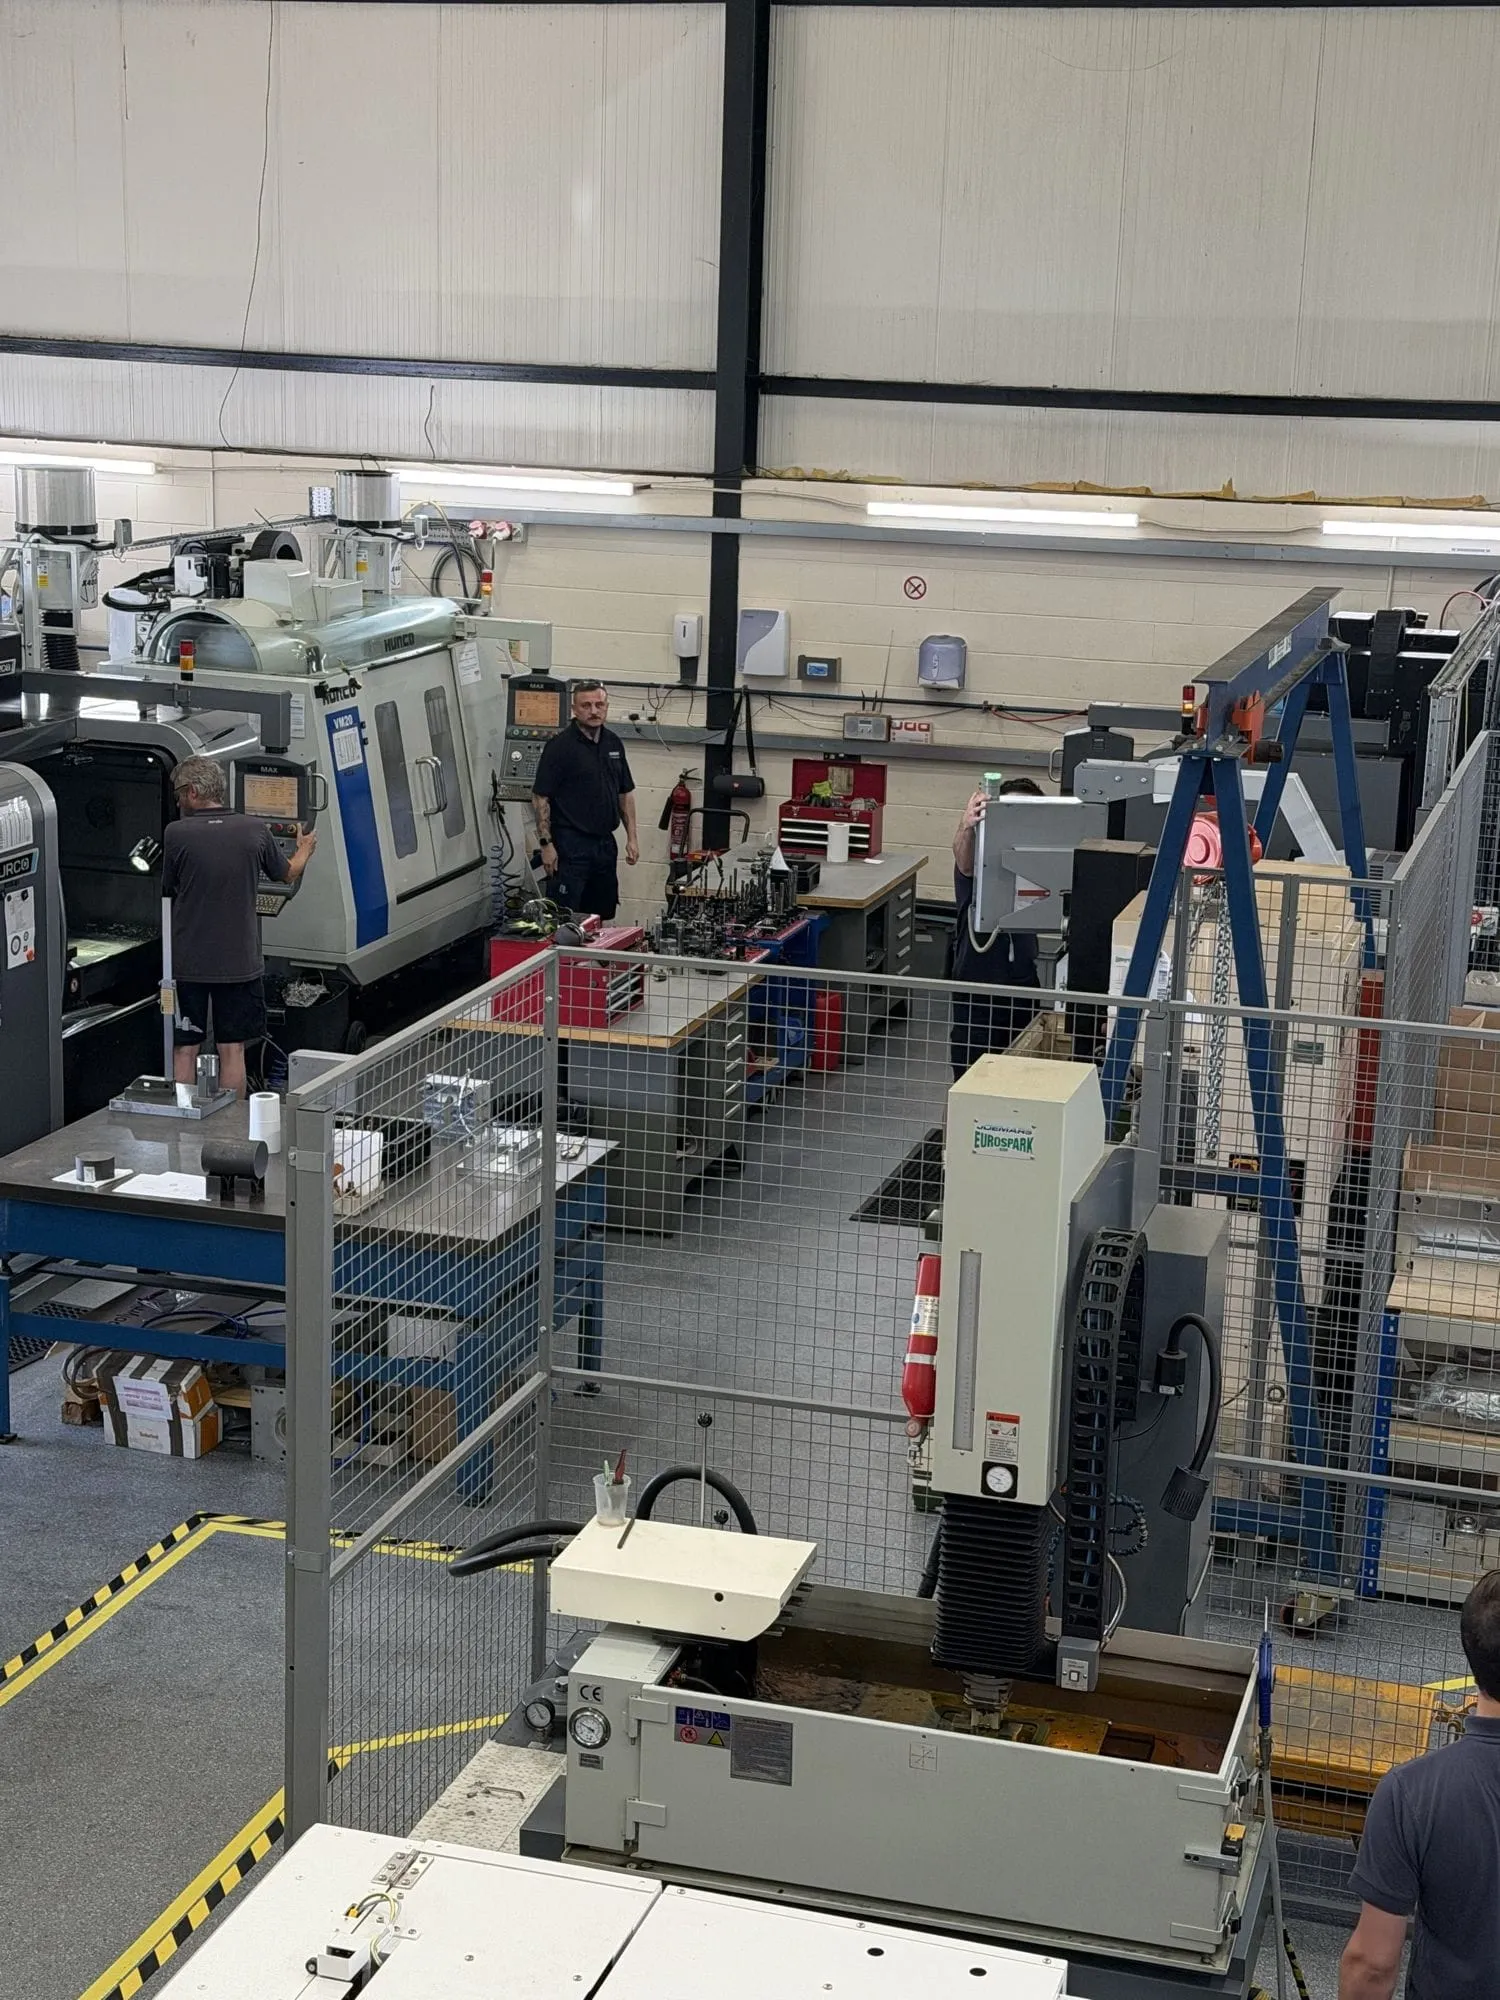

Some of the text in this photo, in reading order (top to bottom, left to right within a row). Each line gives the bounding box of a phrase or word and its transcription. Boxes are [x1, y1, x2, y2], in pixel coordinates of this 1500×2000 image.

[384, 632, 415, 652] HURCO
[333, 714, 353, 730] VM20
[974, 1130, 1034, 1154] EUROSPARK
[580, 1684, 602, 1702] CE
